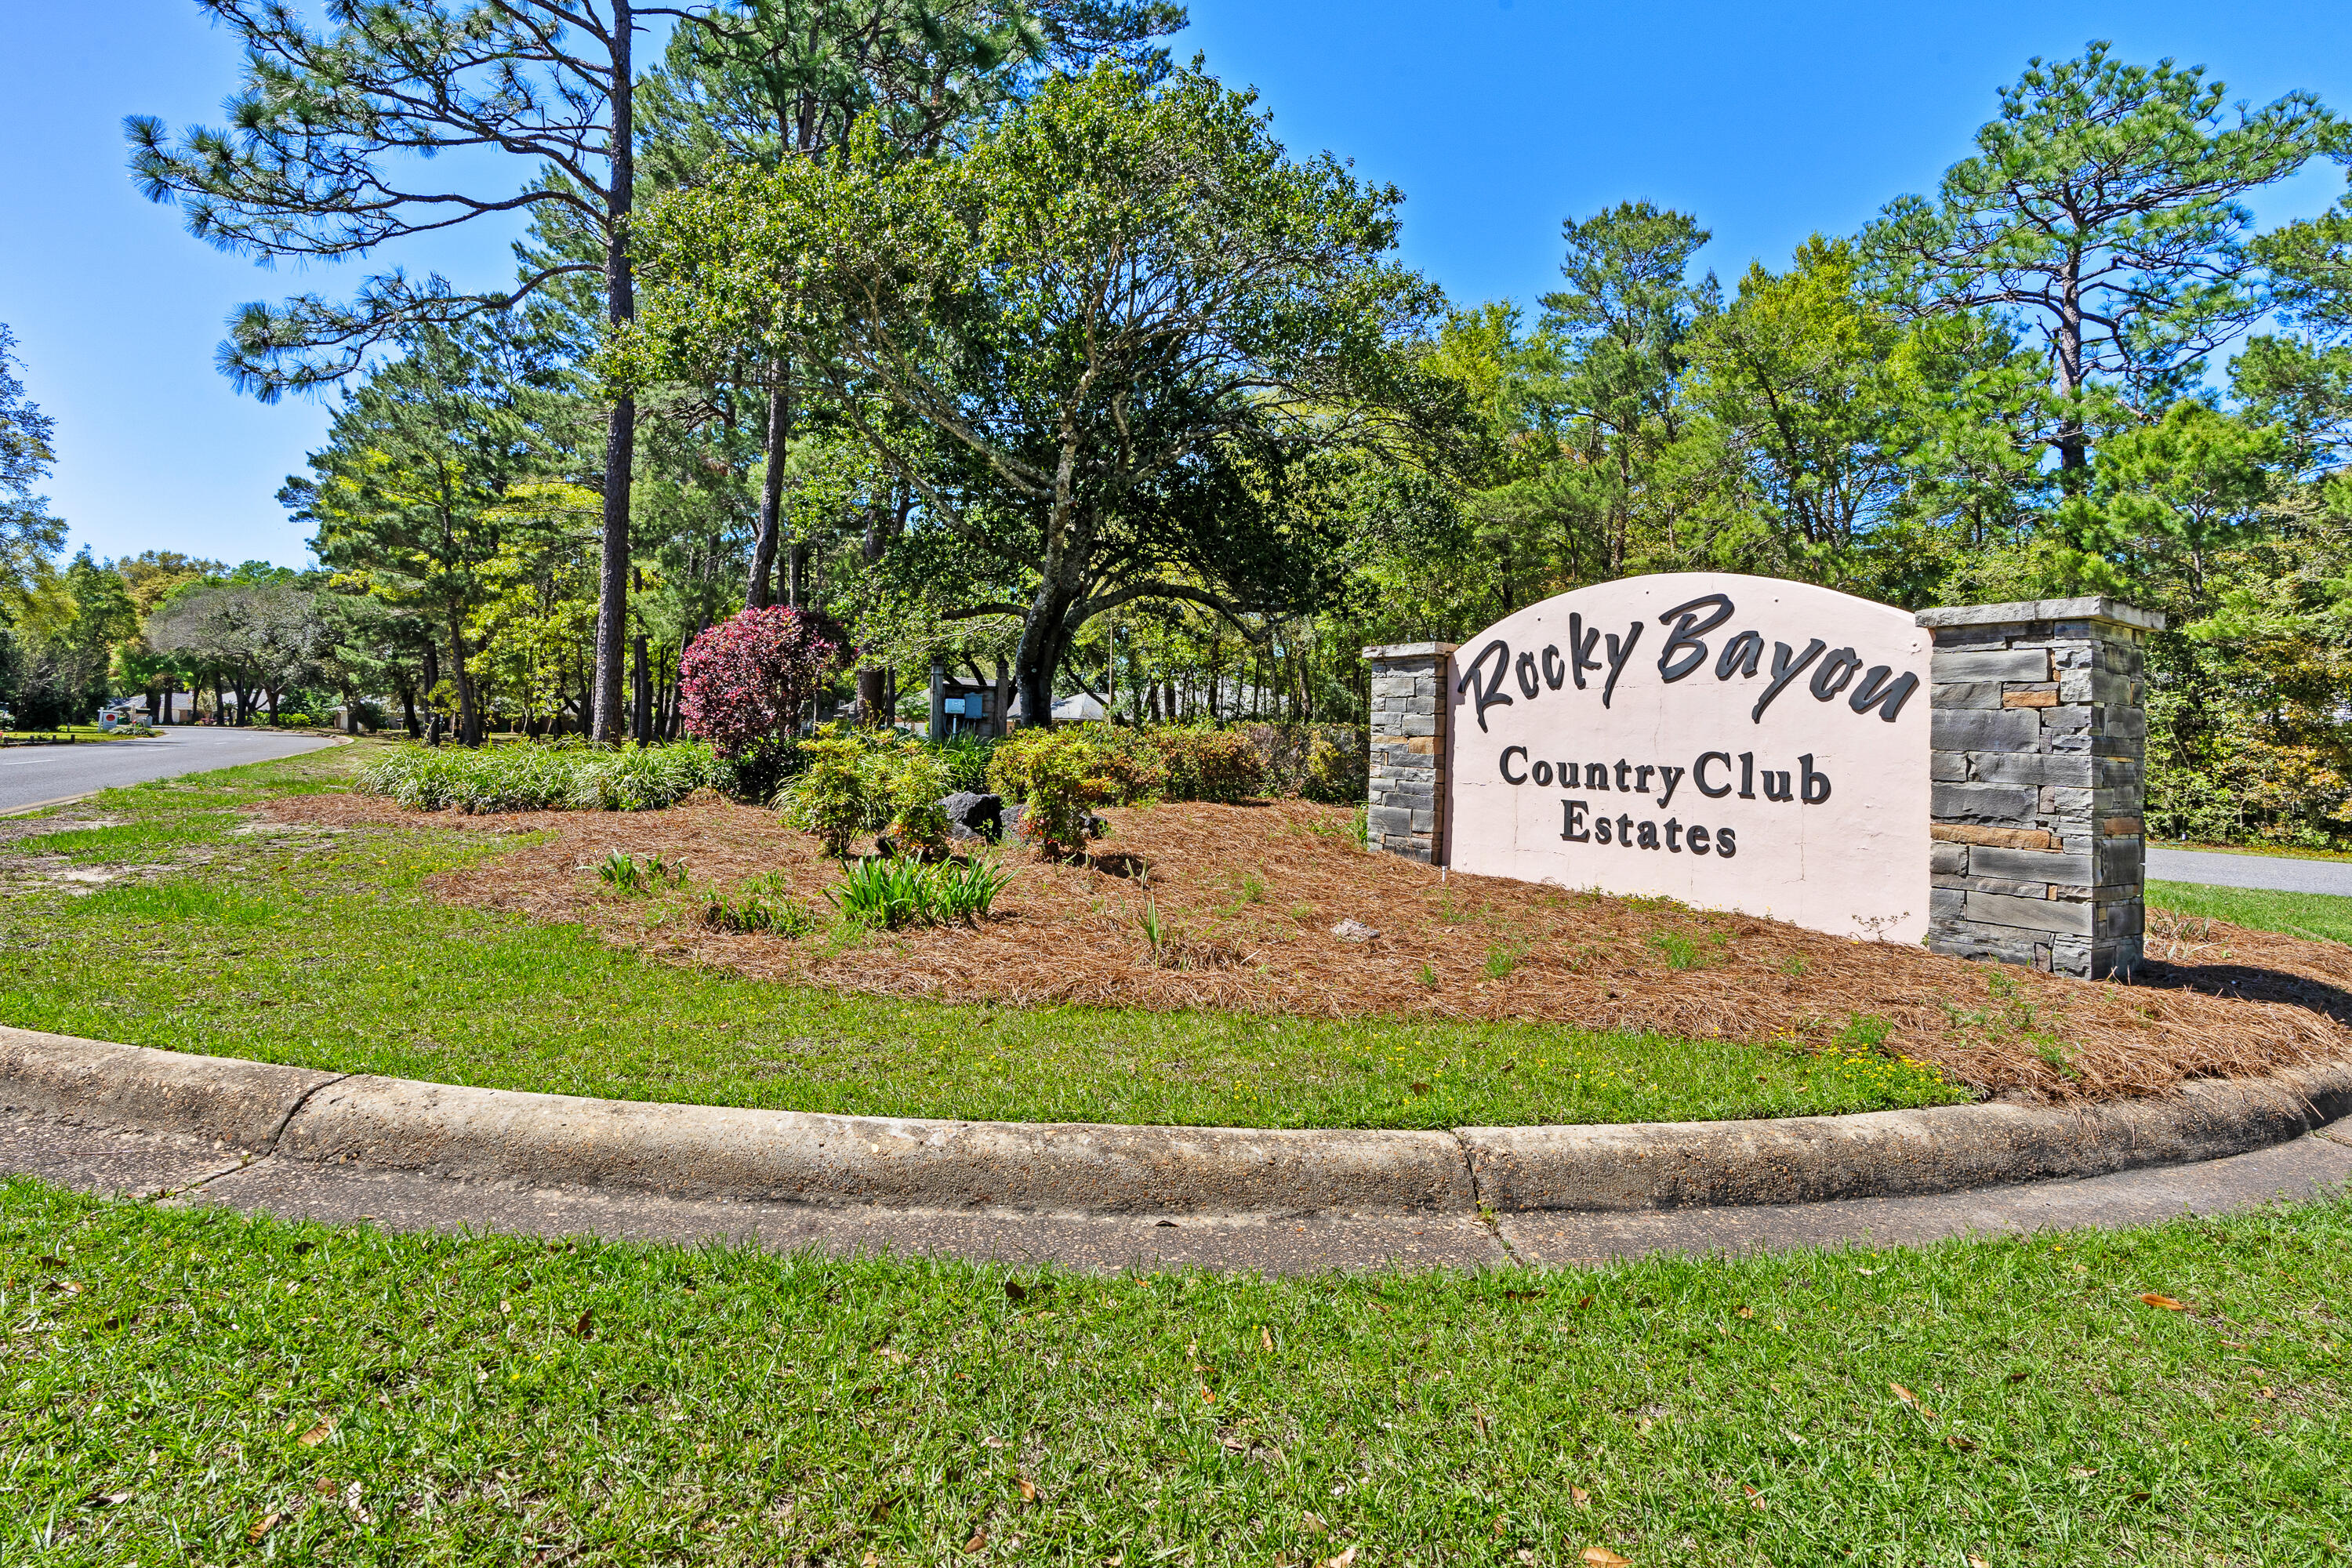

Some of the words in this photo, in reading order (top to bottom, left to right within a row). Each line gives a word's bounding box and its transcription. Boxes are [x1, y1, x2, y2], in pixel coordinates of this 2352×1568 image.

[1457, 612, 1644, 733] Rocky
[1657, 593, 1920, 724] Bayou
[1499, 745, 1686, 808] Country
[1693, 751, 1832, 804] Club
[1559, 799, 1737, 858] Estates
